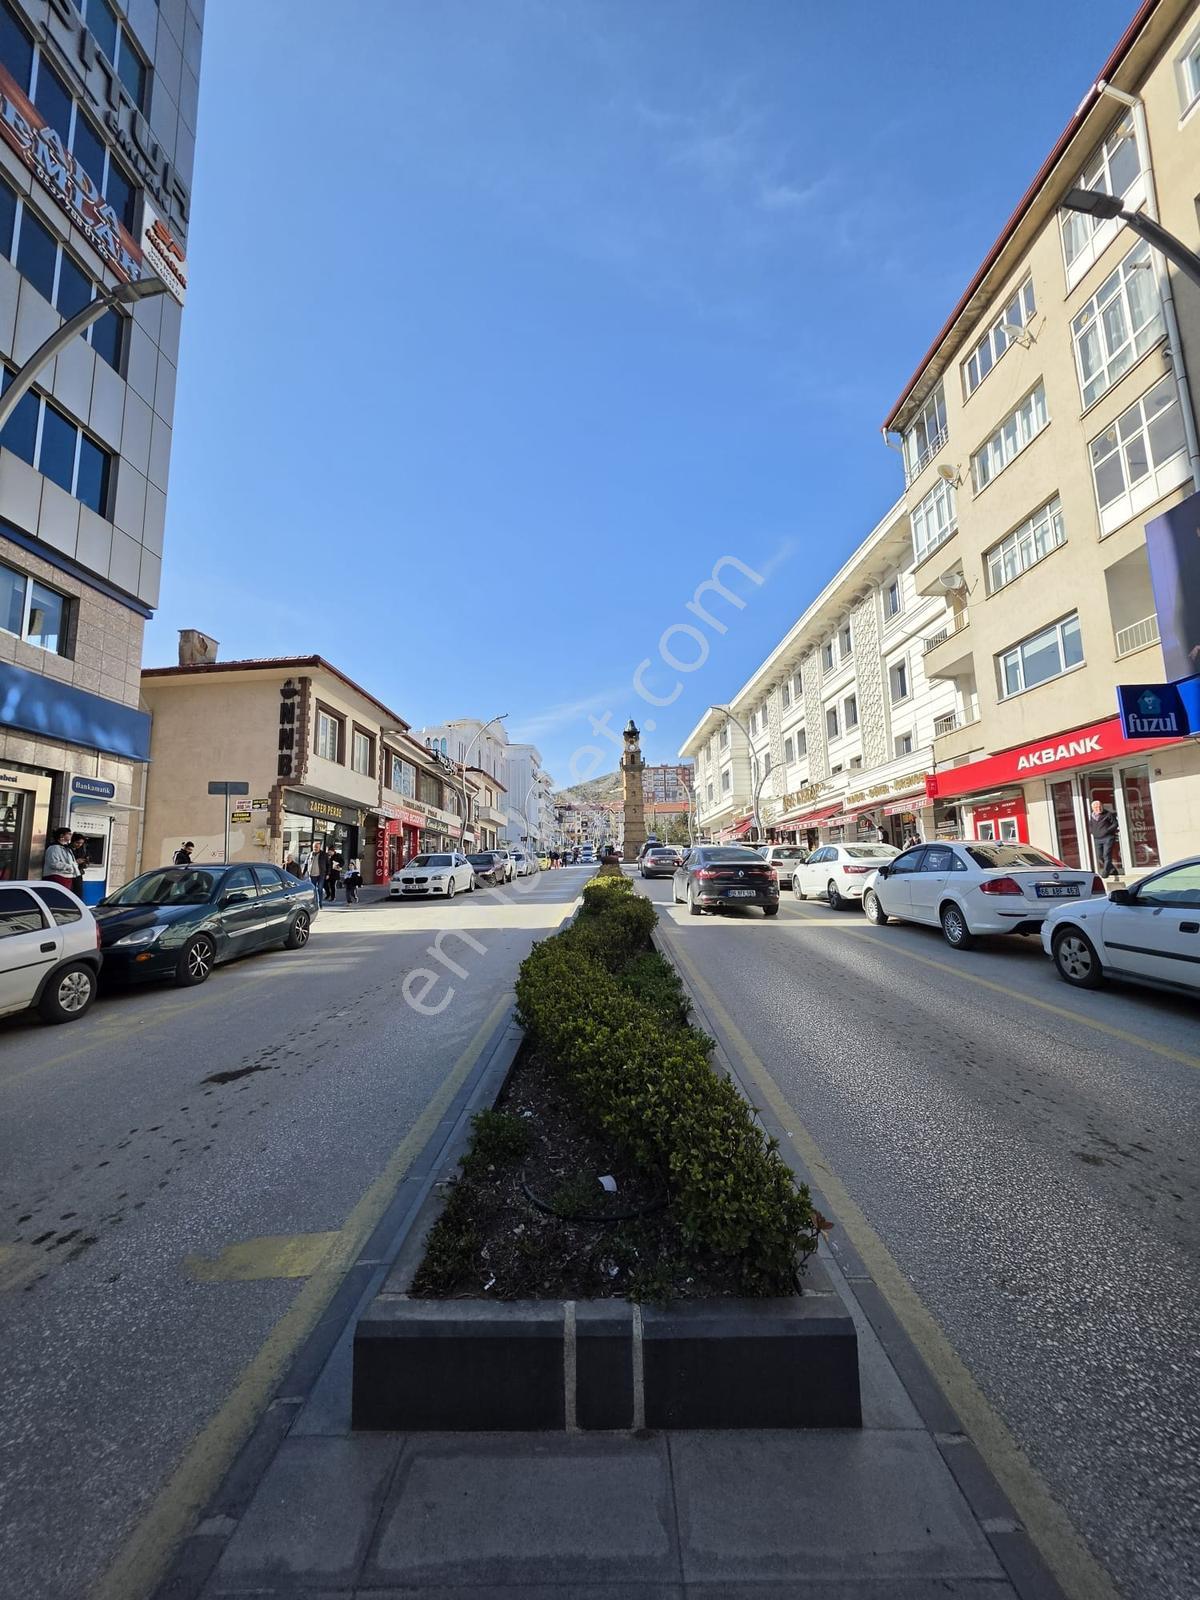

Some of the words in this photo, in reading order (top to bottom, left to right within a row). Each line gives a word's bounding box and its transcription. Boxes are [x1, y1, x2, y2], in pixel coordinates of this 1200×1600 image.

[0, 93, 142, 282] EMLAK
[35, 126, 124, 244] ADA
[1128, 713, 1178, 733] fuzul
[1017, 736, 1102, 770] AKBANK
[75, 782, 111, 794] Bankamatik
[310, 800, 327, 814] ZAFER
[327, 805, 343, 818] PERDE
